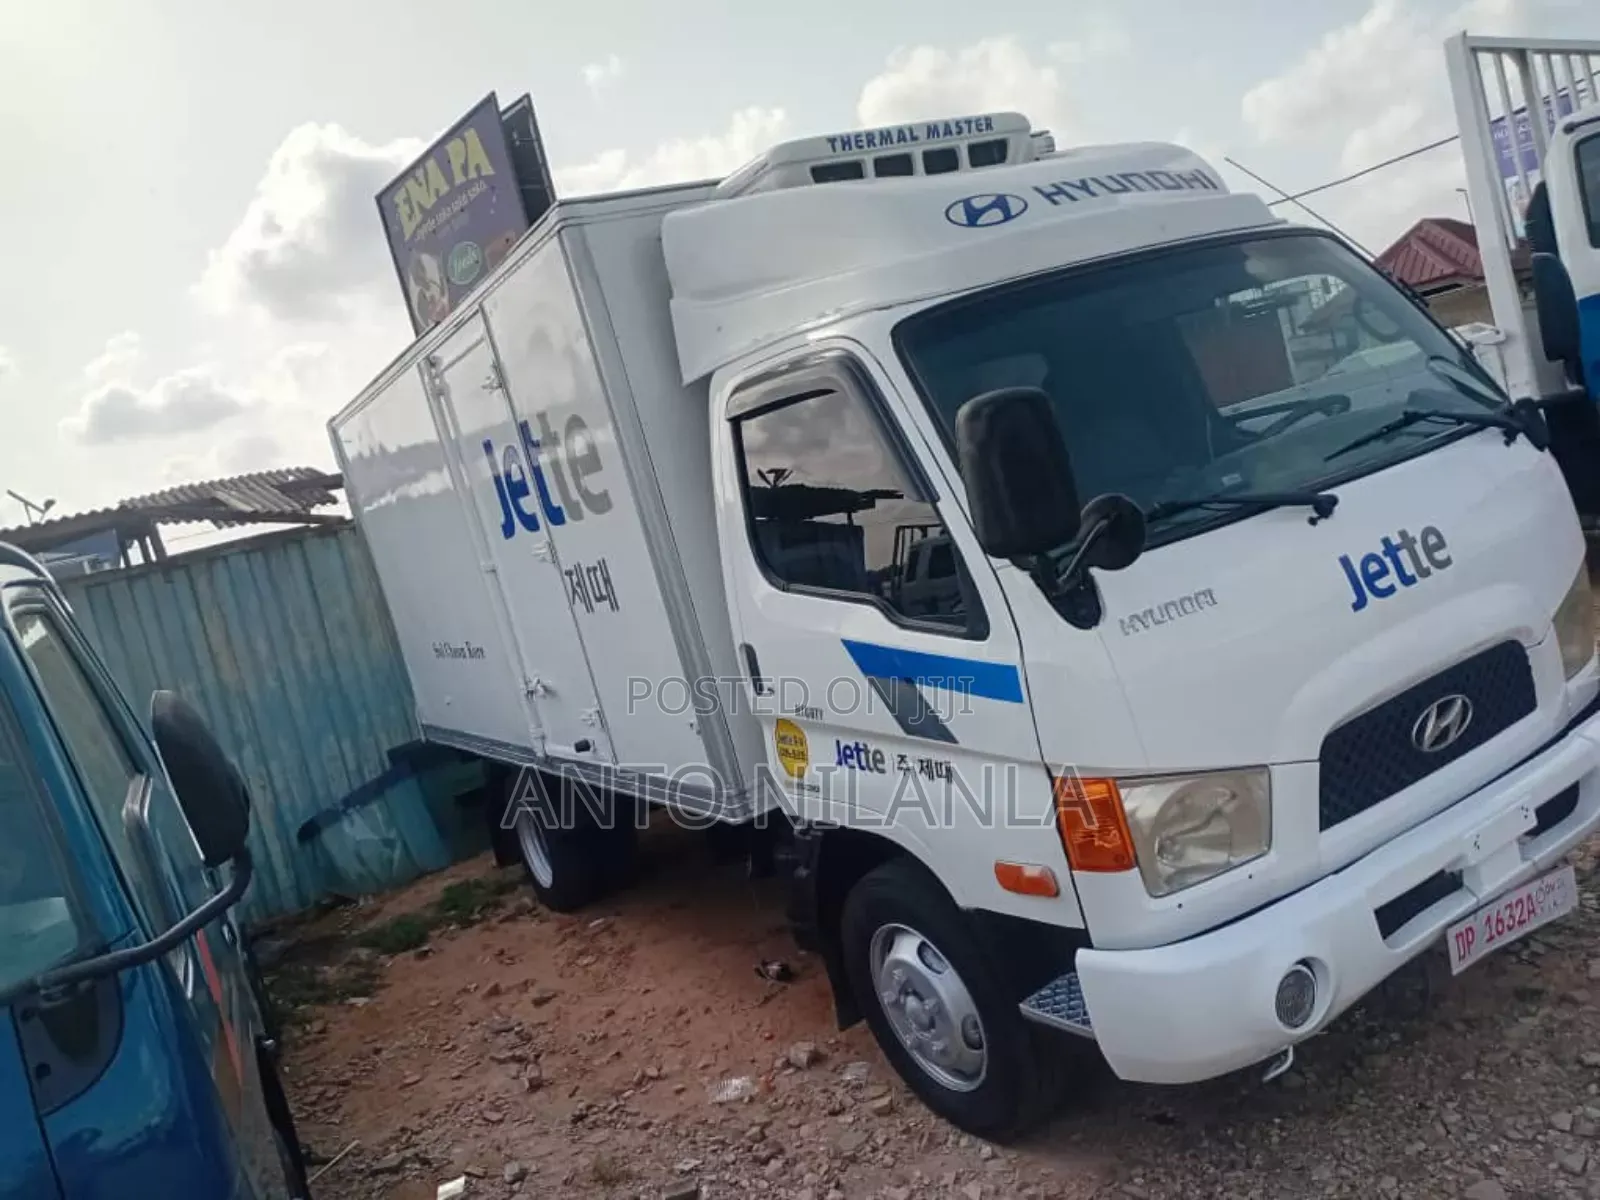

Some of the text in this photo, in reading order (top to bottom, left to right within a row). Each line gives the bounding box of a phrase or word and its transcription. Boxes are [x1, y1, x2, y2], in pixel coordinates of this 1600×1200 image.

[826, 116, 995, 154] THERMAL MASTER
[394, 158, 448, 241] ENA
[446, 128, 495, 186] PA
[482, 411, 613, 540] Jette
[564, 556, 620, 615] 제때
[1338, 525, 1453, 613] Jette
[834, 739, 887, 775] Jette
[1455, 925, 1476, 963] DP
